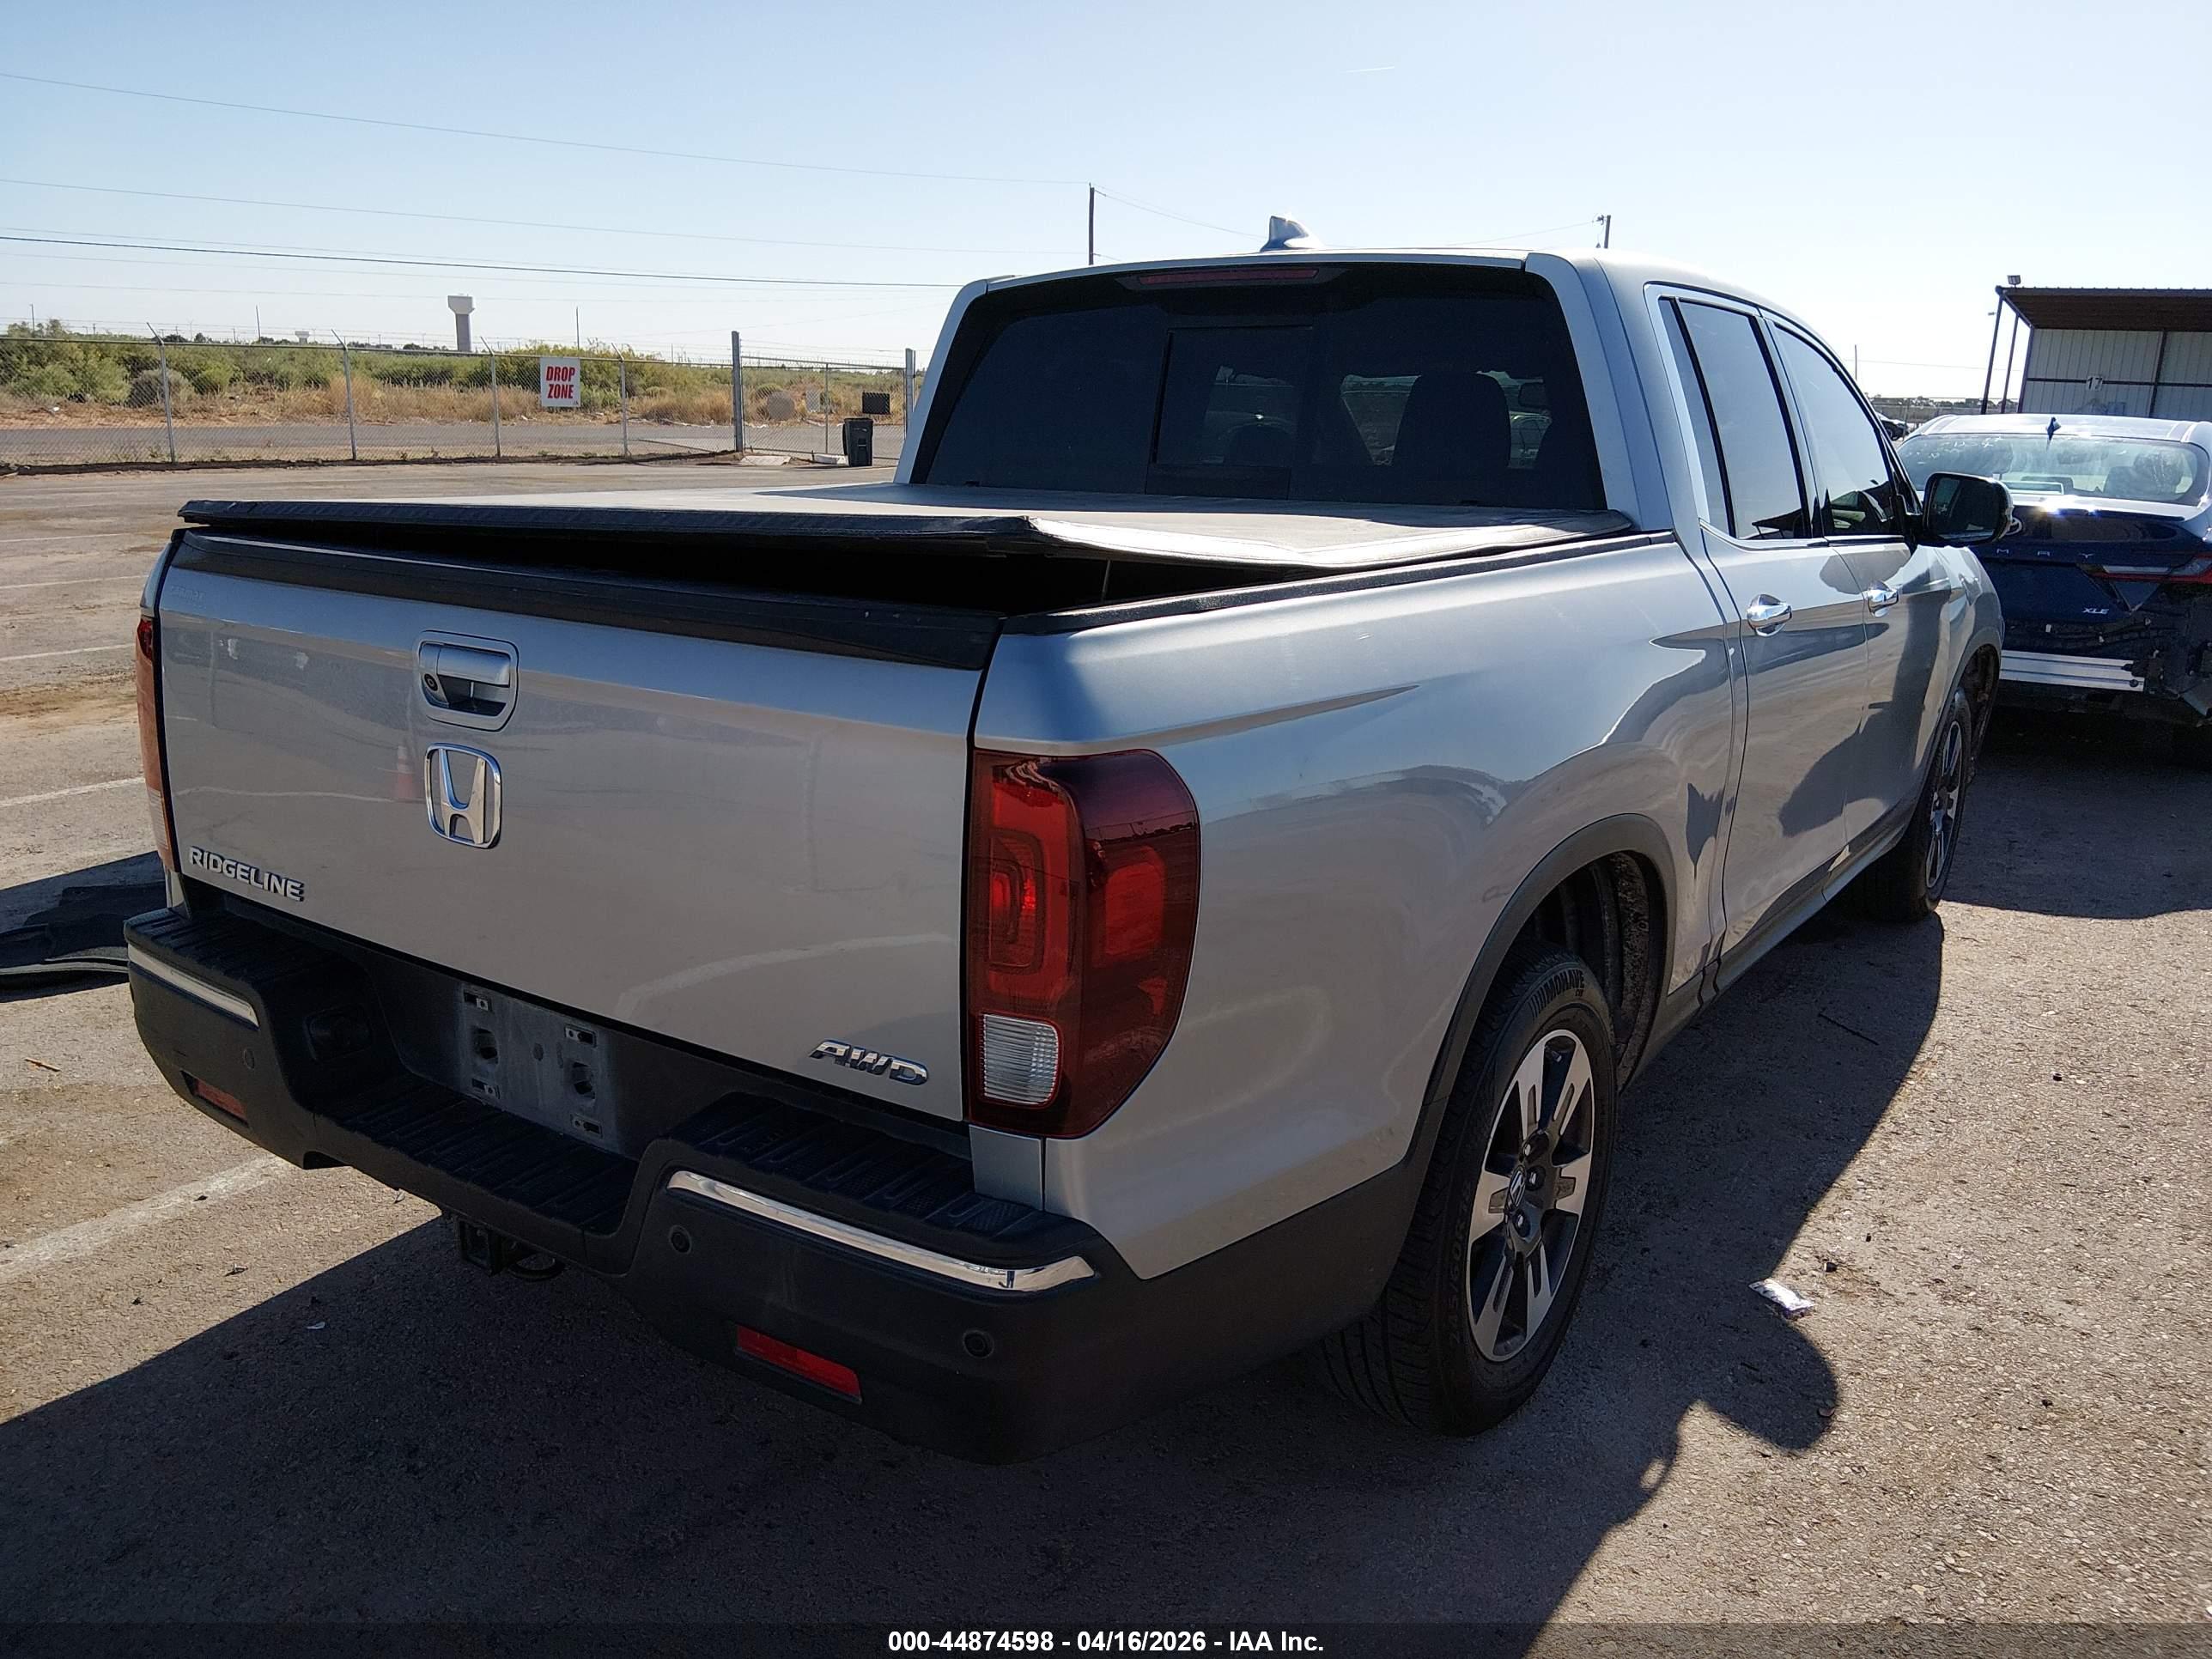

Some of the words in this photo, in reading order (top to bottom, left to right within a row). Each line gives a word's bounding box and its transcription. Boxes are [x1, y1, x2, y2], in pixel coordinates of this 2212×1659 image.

[546, 367, 575, 381] DROP
[2087, 377, 2103, 390] 17
[548, 384, 574, 398] ZONE
[2081, 606, 2110, 615] XLE
[189, 846, 304, 902] RIDGELINE
[809, 1038, 929, 1086] AWD
